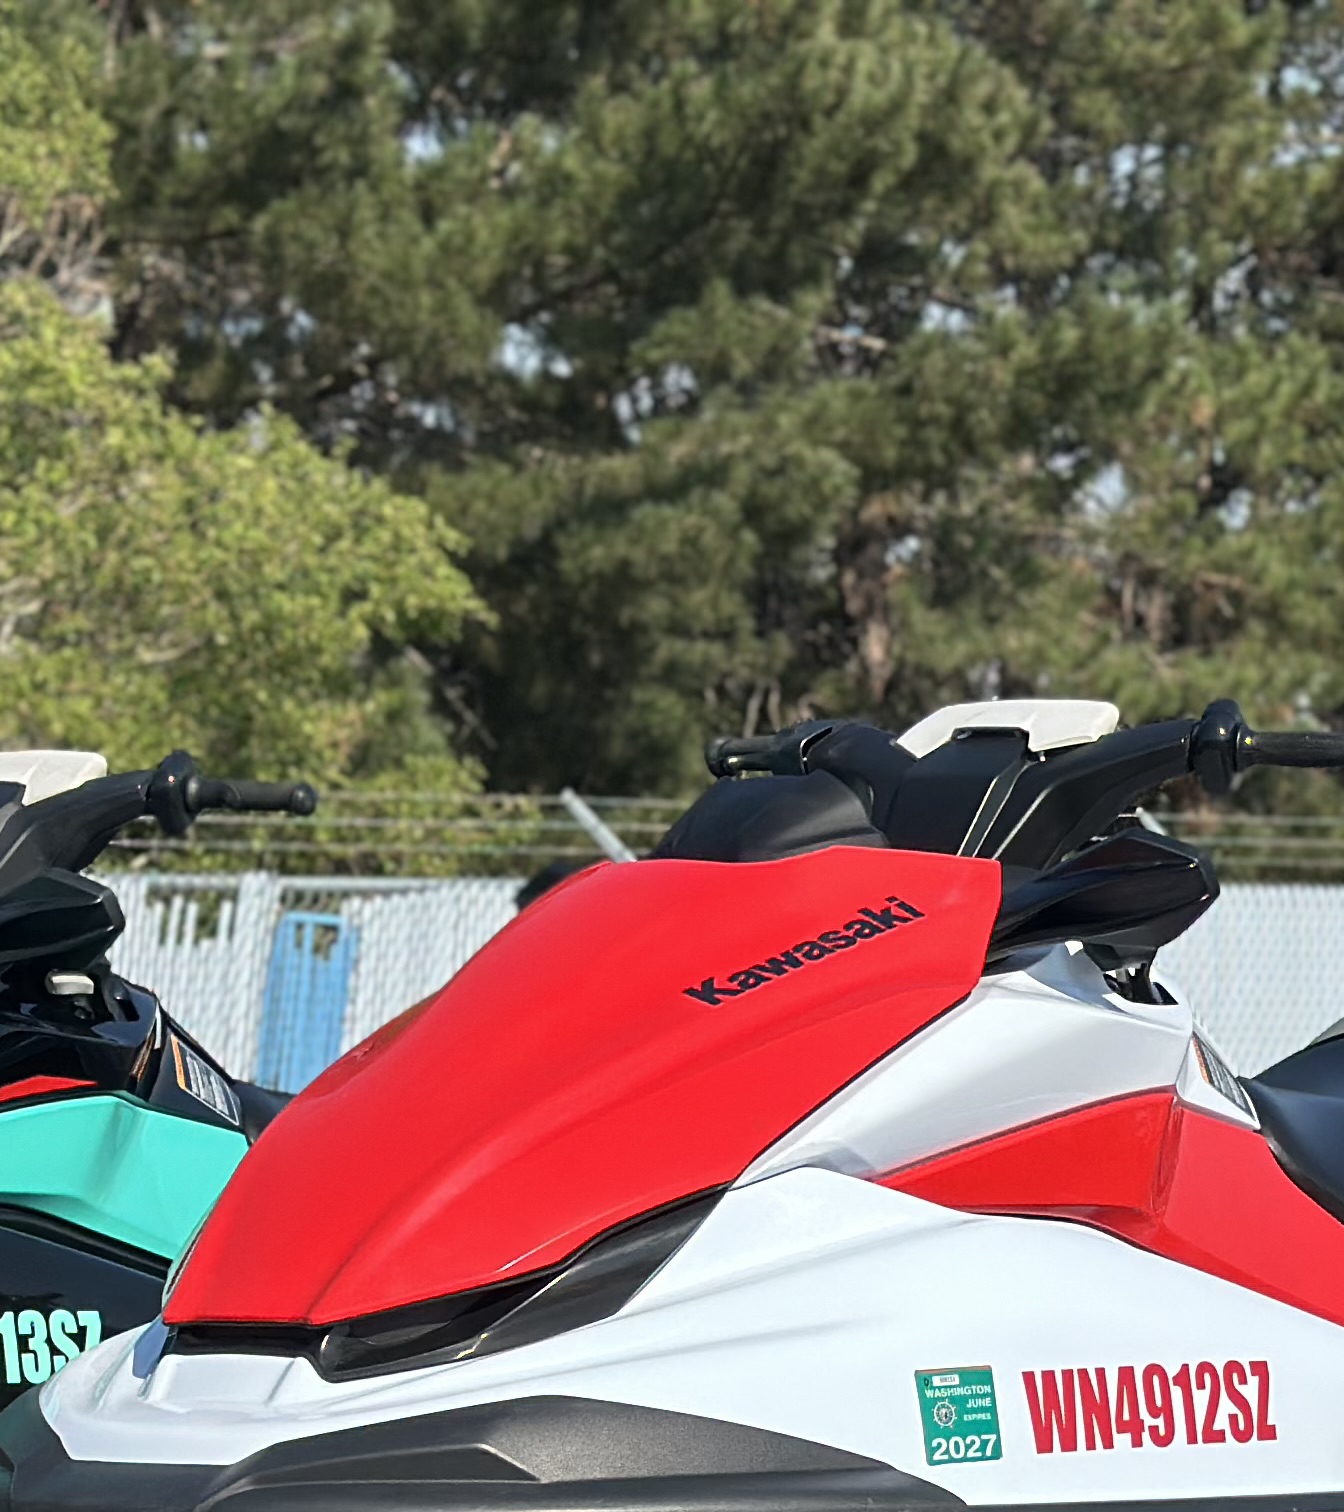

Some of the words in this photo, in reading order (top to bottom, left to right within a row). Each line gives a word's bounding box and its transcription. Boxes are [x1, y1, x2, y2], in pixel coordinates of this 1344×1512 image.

[682, 895, 926, 1006] Kawasaki
[924, 1384, 992, 1399] WASHINGTON
[966, 1397, 993, 1408] JUNE
[1022, 1360, 1278, 1455] WN4912SZ
[931, 1434, 997, 1461] 2027
